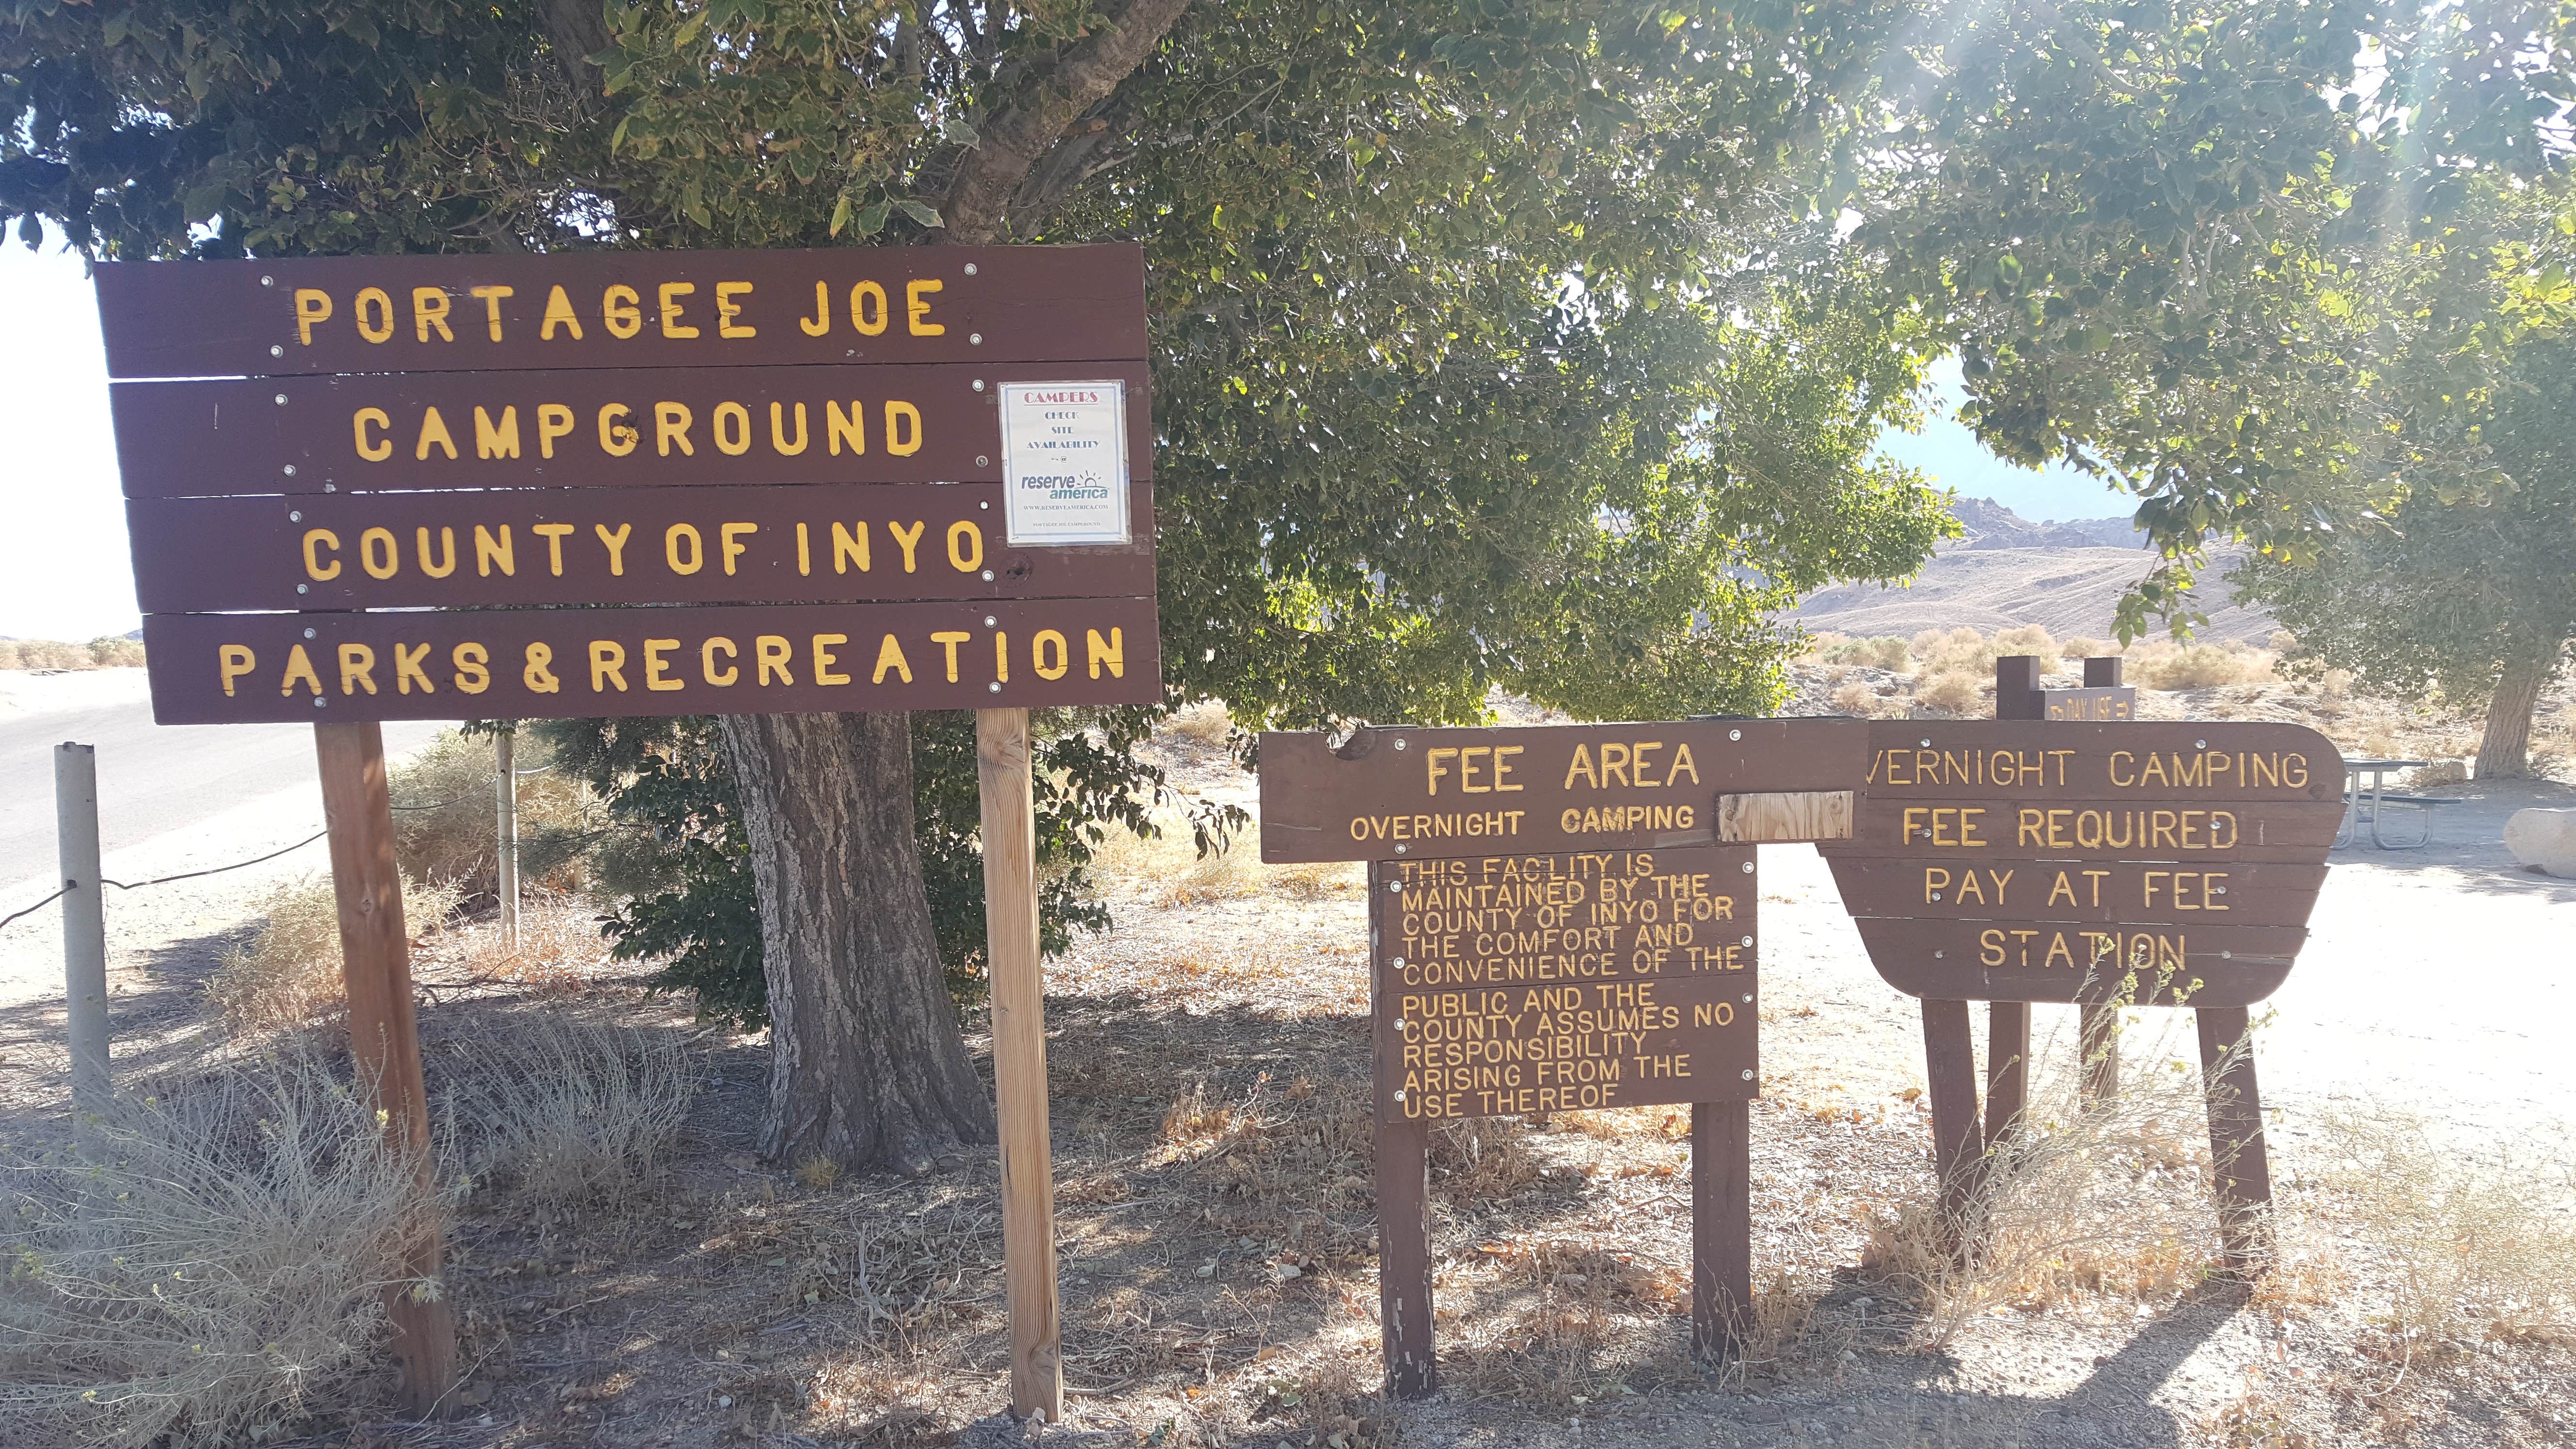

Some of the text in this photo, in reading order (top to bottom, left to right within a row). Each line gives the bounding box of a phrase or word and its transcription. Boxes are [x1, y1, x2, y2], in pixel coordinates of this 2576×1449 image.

[295, 279, 945, 345] PORTAGEE JOE
[1024, 391, 1098, 403] CAMPERS
[1045, 411, 1079, 419] CHECK
[354, 400, 922, 461] CAMPGROUND
[1027, 441, 1100, 449] AVAILABILITY
[1021, 476, 1075, 489] reserve
[1049, 489, 1108, 499] america
[303, 520, 983, 580] COUNTY OF INYO
[220, 627, 1123, 695] PARKS & RECREATION
[1427, 742, 1699, 795] FEE AREA
[1867, 749, 2307, 787] VERNIGHT CAMPING
[1351, 805, 1694, 840] OVERNIGHT CAMPING
[1904, 808, 2238, 848] FEE REQUIRED
[1399, 861, 1468, 887] THIS
[1626, 853, 1654, 877] IS
[1926, 868, 2227, 909] PAY AT FEE
[1402, 874, 1711, 912] MAINTAINED BY THE
[1403, 896, 1733, 935] COUNTY OF INYO FOR
[1402, 922, 1693, 958] THE COMFORT AND
[1981, 930, 2185, 972] STATION
[1403, 946, 1743, 986] CONVENIENCE OF THE
[1403, 982, 1655, 1019] PUBLIC AND THE
[1403, 1002, 1734, 1043] COUNTY ASSUMES NO
[1403, 1032, 1648, 1068] RESPONSIBILITY
[1404, 1054, 1690, 1092] ARISING FROM THE
[1404, 1083, 1618, 1117] USE THEREOF
